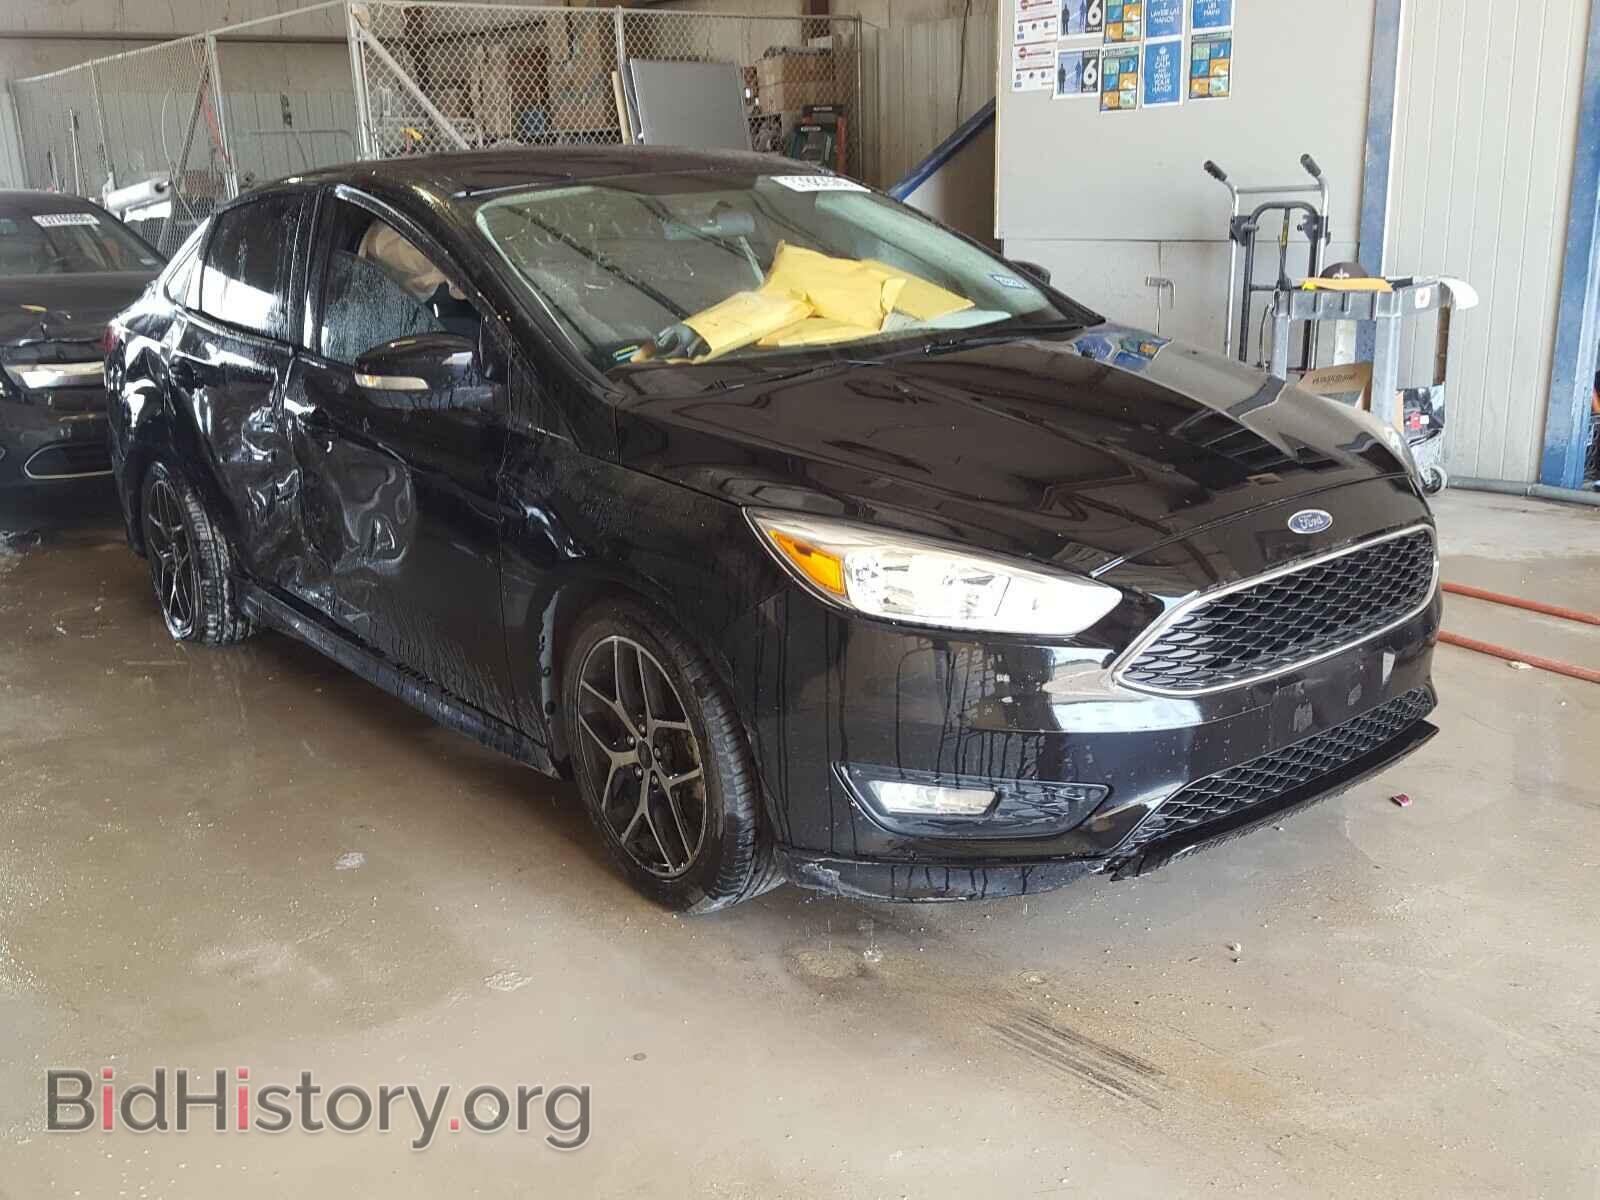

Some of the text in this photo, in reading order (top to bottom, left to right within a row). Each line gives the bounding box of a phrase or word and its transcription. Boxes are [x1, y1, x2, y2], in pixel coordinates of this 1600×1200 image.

[1088, 0, 1101, 26] 6
[1083, 58, 1098, 86] 6
[1298, 514, 1324, 529] Ford
